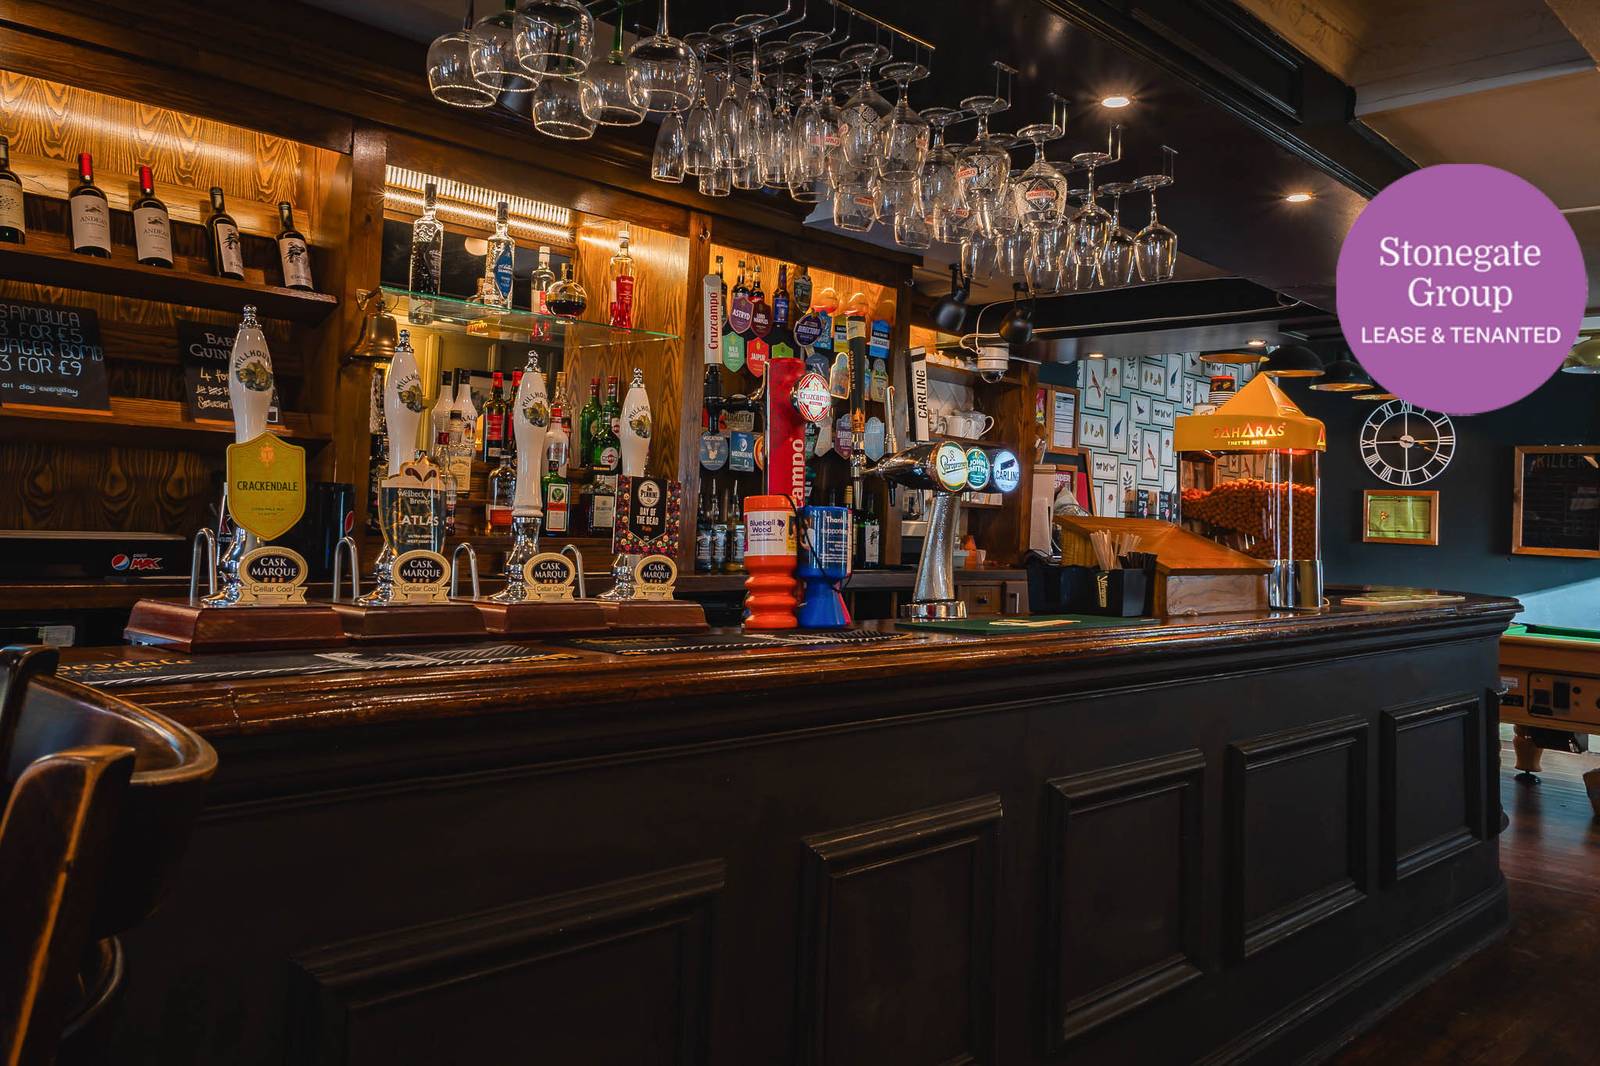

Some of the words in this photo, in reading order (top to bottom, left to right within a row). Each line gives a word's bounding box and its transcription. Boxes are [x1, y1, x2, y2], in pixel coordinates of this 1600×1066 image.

[709, 291, 721, 350] Cruzcampo
[18, 321, 54, 341] FOR
[18, 356, 53, 374] FOR
[58, 360, 82, 376] £9
[916, 368, 927, 419] CARLING
[1213, 422, 1285, 439] SAHARAS
[237, 481, 298, 492] CRACKENDALE
[401, 515, 440, 527] ATLAS
[636, 515, 646, 525] THE
[749, 519, 776, 527] Bluebell
[129, 557, 163, 570] MAX
[260, 557, 288, 567] CASK
[409, 559, 434, 569] CASK
[539, 561, 560, 571] CASK
[251, 567, 297, 578] MARQUE
[648, 563, 666, 572] CASK
[402, 568, 442, 579] MARQUE
[534, 570, 568, 579] MARQUE
[642, 571, 671, 580] MARQUE
[253, 585, 274, 593] Cellar
[275, 585, 292, 593] Cool
[423, 585, 438, 593] Cool
